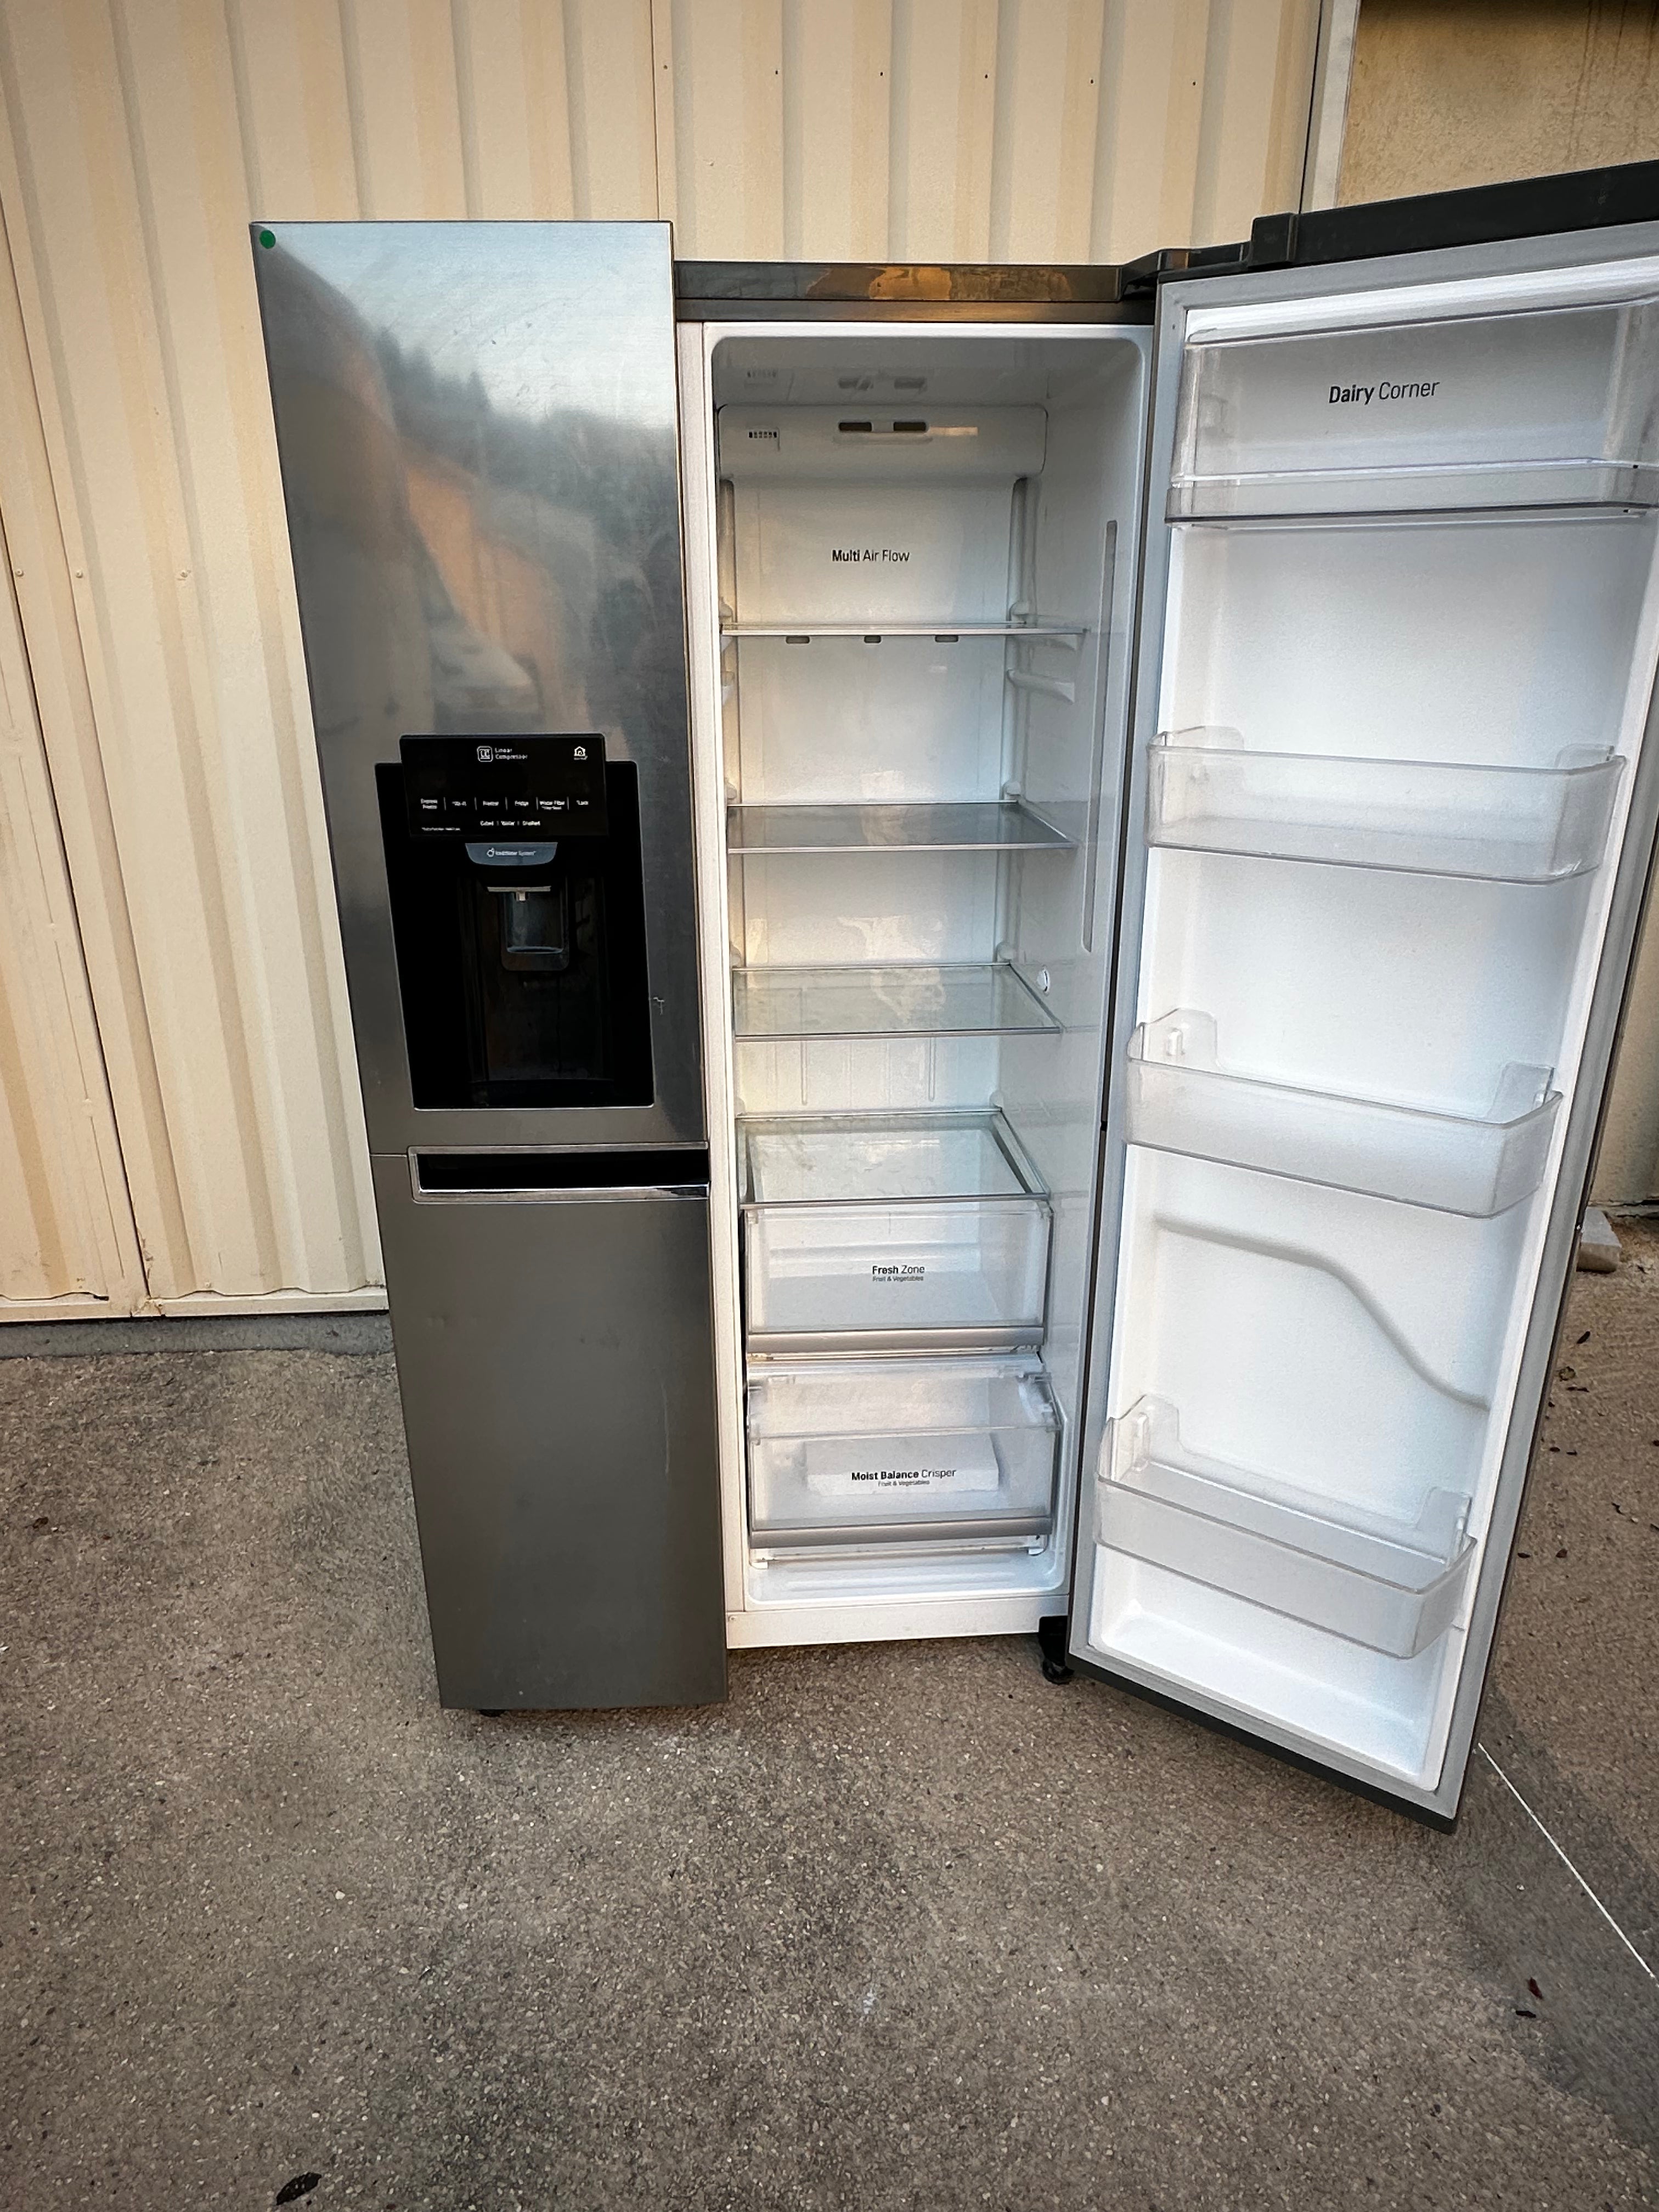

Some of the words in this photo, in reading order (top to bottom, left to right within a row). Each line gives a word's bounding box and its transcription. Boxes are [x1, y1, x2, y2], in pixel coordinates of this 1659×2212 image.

[1329, 385, 1375, 405] Dairy
[1379, 382, 1440, 400] Corner
[832, 550, 860, 561] Multi
[863, 550, 879, 561] Air
[883, 550, 910, 562] Flow
[872, 1265, 899, 1274] Fresh
[901, 1265, 925, 1273] Zone
[851, 1472, 878, 1480] Moist
[881, 1471, 919, 1480] Balance
[921, 1470, 957, 1479] Crisper
